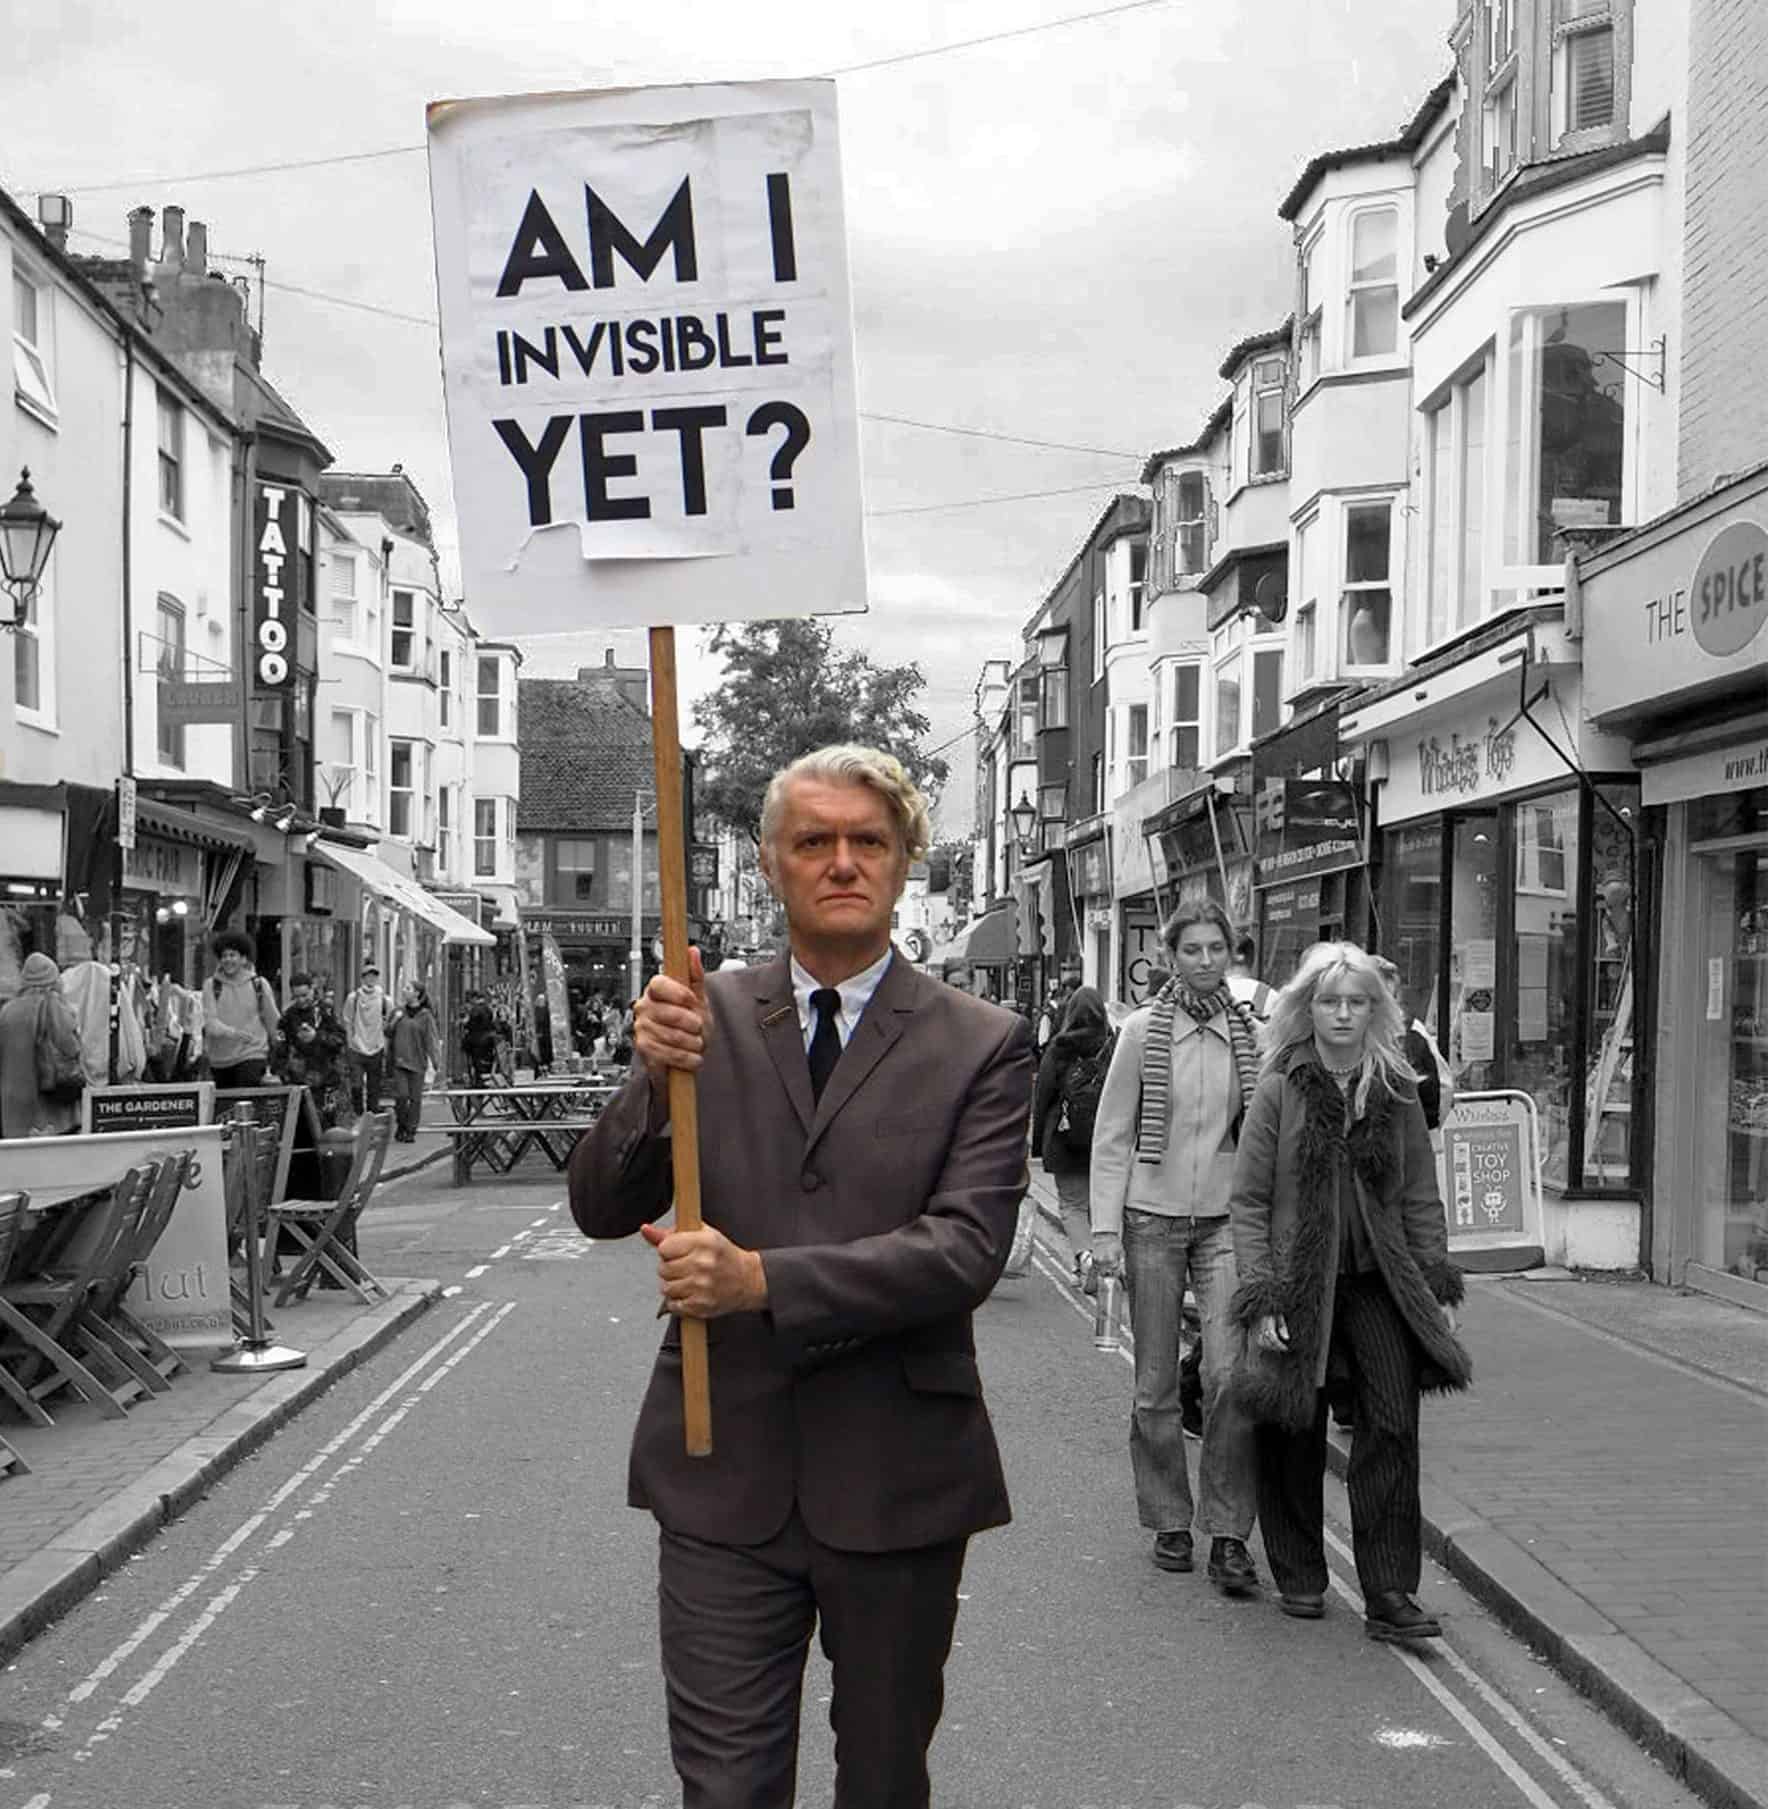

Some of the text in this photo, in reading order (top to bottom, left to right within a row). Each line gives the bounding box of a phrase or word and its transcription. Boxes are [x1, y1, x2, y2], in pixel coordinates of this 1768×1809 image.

[495, 172, 798, 298] AM I
[496, 308, 790, 387] INVISIBLE
[258, 486, 289, 686] TATTOO
[1645, 551, 1765, 644] THE SPICE
[98, 1099, 194, 1114] THE GARDENER
[1473, 1169, 1511, 1184] SHOP
[1475, 1153, 1507, 1169] TOY
